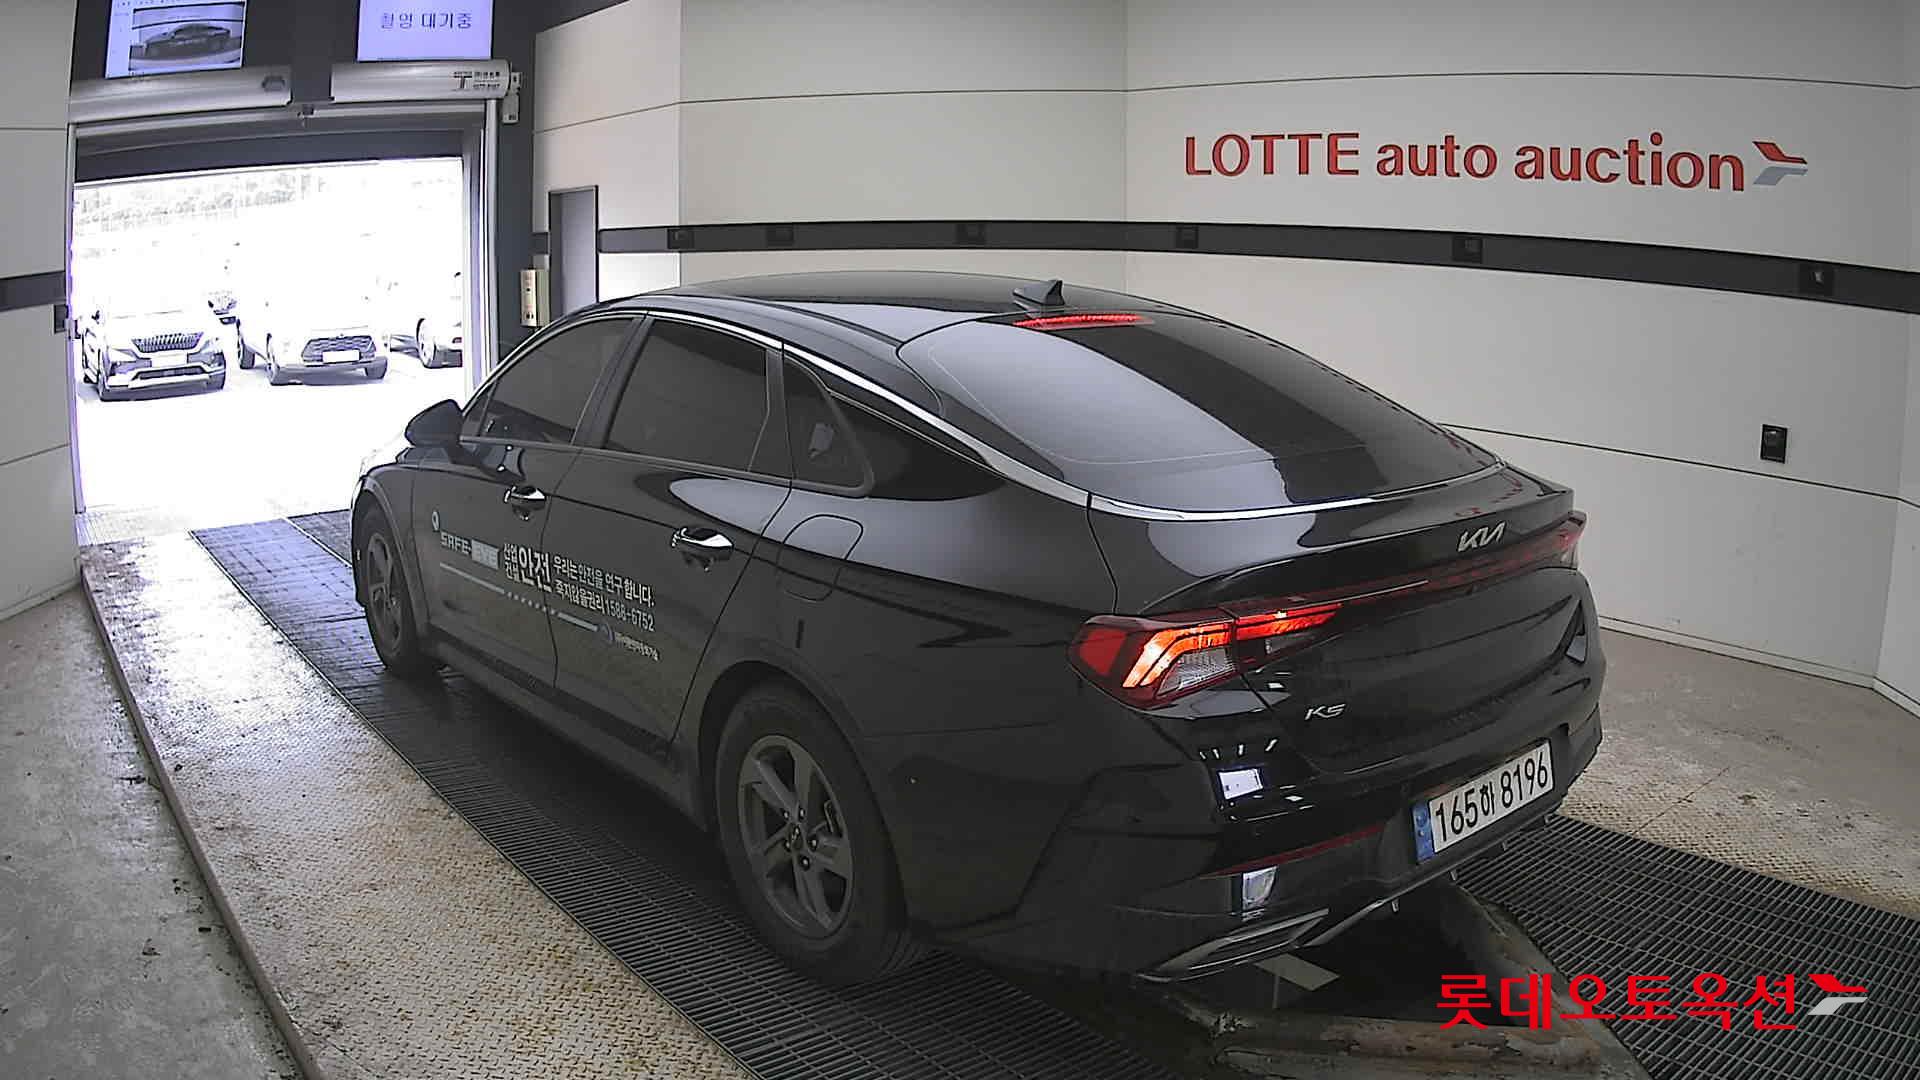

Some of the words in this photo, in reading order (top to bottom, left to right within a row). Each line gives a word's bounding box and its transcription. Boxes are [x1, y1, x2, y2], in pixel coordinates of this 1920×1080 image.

[421, 12, 472, 29] 대기중
[1185, 131, 1360, 177] LOTTE
[1376, 134, 1498, 178] auto
[1514, 131, 1745, 192] auction
[519, 546, 552, 592] 안전
[1304, 703, 1346, 720] K5
[1435, 781, 1495, 842] 165하
[1500, 752, 1548, 809] 8196
